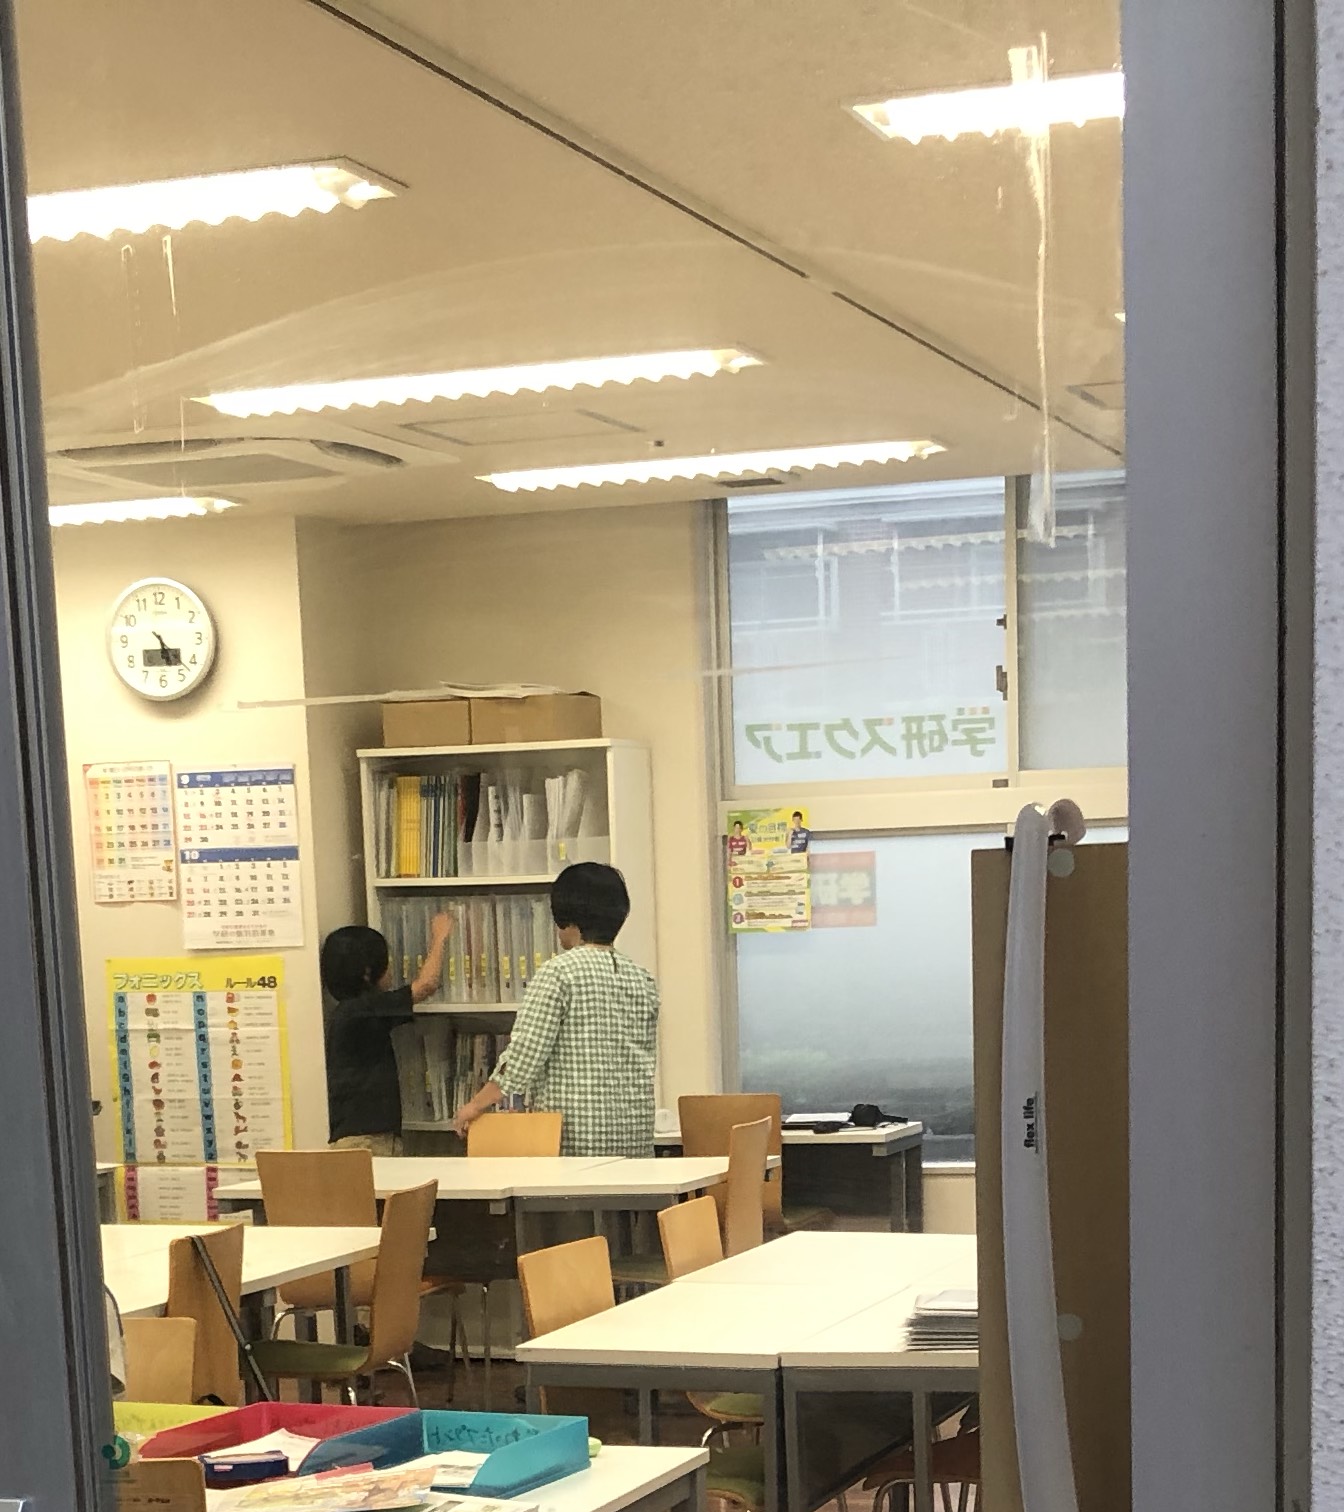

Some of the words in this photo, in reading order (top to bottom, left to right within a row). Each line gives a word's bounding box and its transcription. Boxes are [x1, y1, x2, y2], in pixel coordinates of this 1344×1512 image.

[136, 598, 147, 611] 11
[153, 592, 165, 605] 12
[175, 597, 180, 610] 1
[125, 615, 136, 627] 10
[189, 611, 195, 623] 2
[120, 635, 128, 648] 9
[195, 632, 202, 645] 3
[128, 656, 134, 668] 8
[189, 655, 197, 665] 4
[143, 671, 149, 683] 7
[160, 675, 167, 688] 6
[178, 670, 185, 682] 5
[184, 851, 200, 860] 10
[113, 972, 204, 990] フォニックス
[226, 975, 278, 989] ルール48
